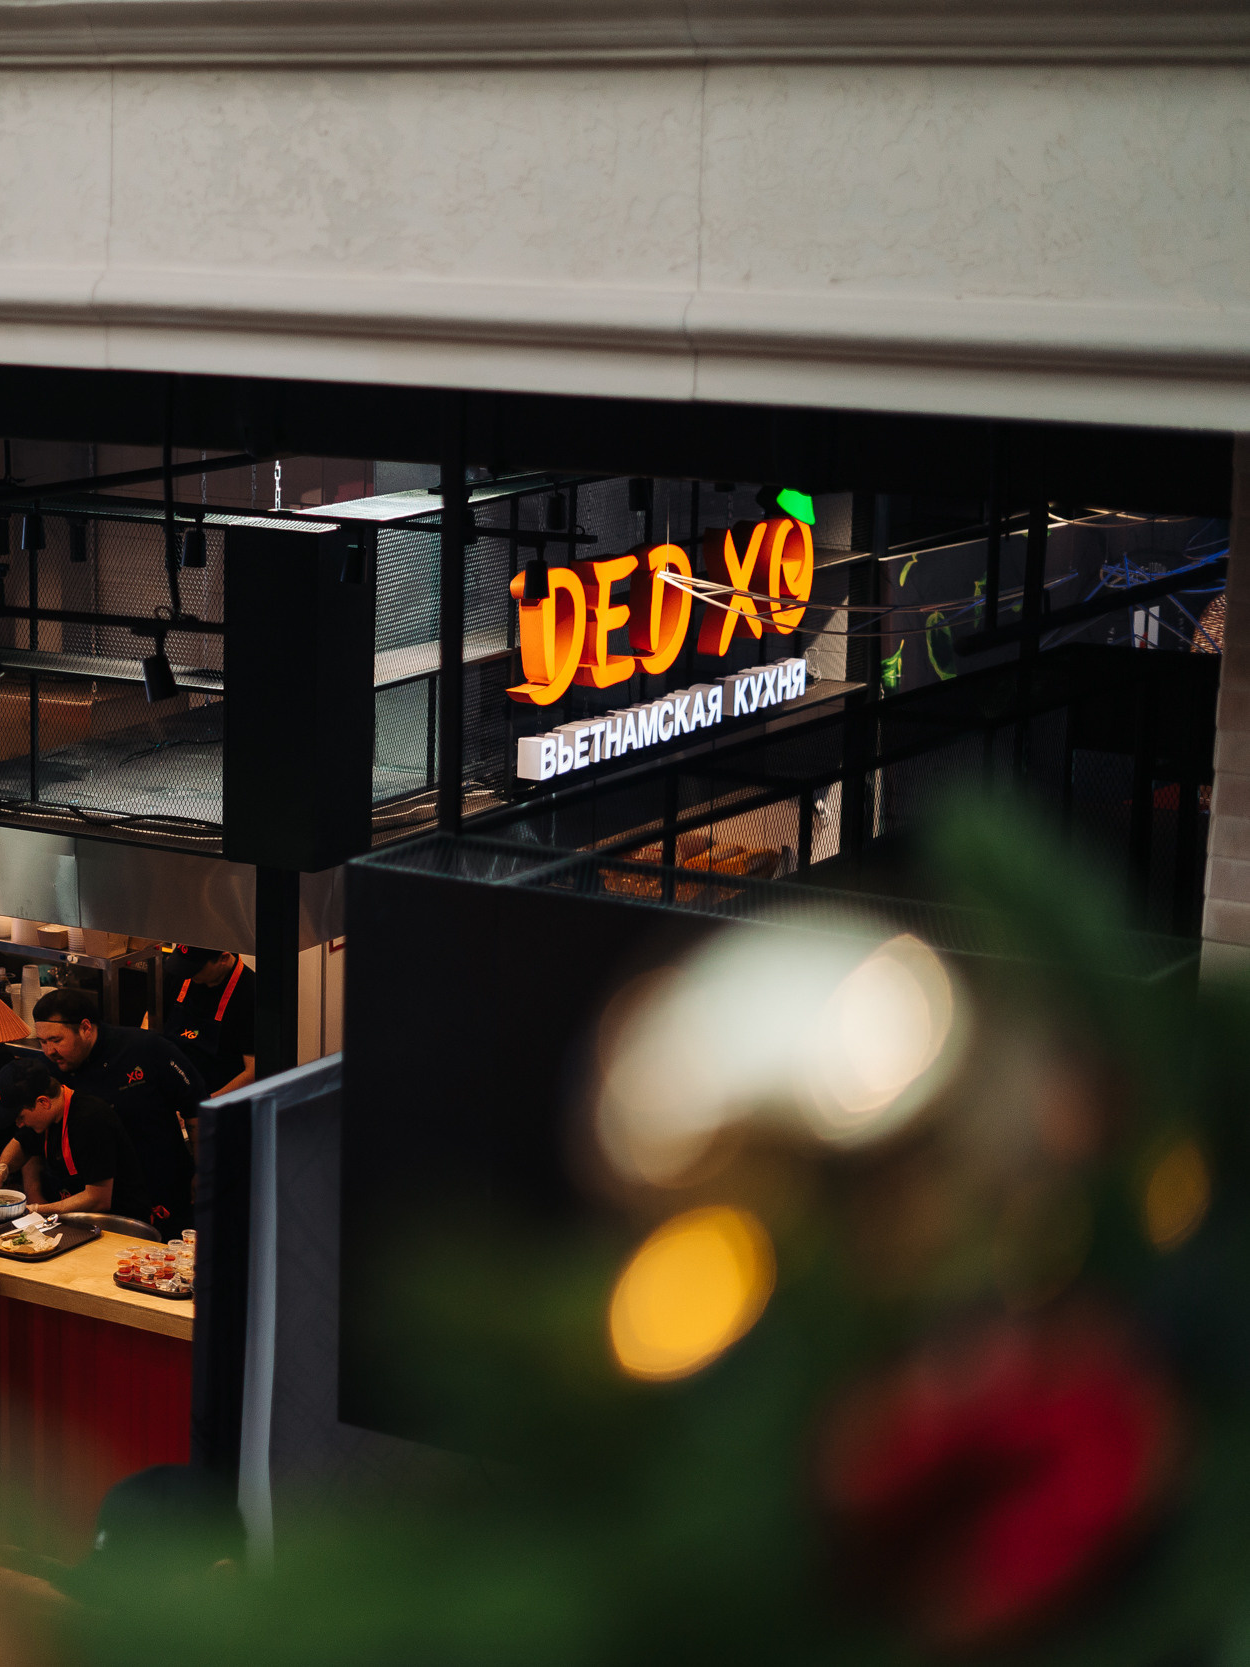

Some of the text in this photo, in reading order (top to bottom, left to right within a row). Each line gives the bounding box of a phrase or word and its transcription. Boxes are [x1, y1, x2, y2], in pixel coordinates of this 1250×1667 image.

[506, 543, 693, 706] DED
[539, 658, 807, 781] ВЬЕТНАМСКАЯ КУХНЯ
